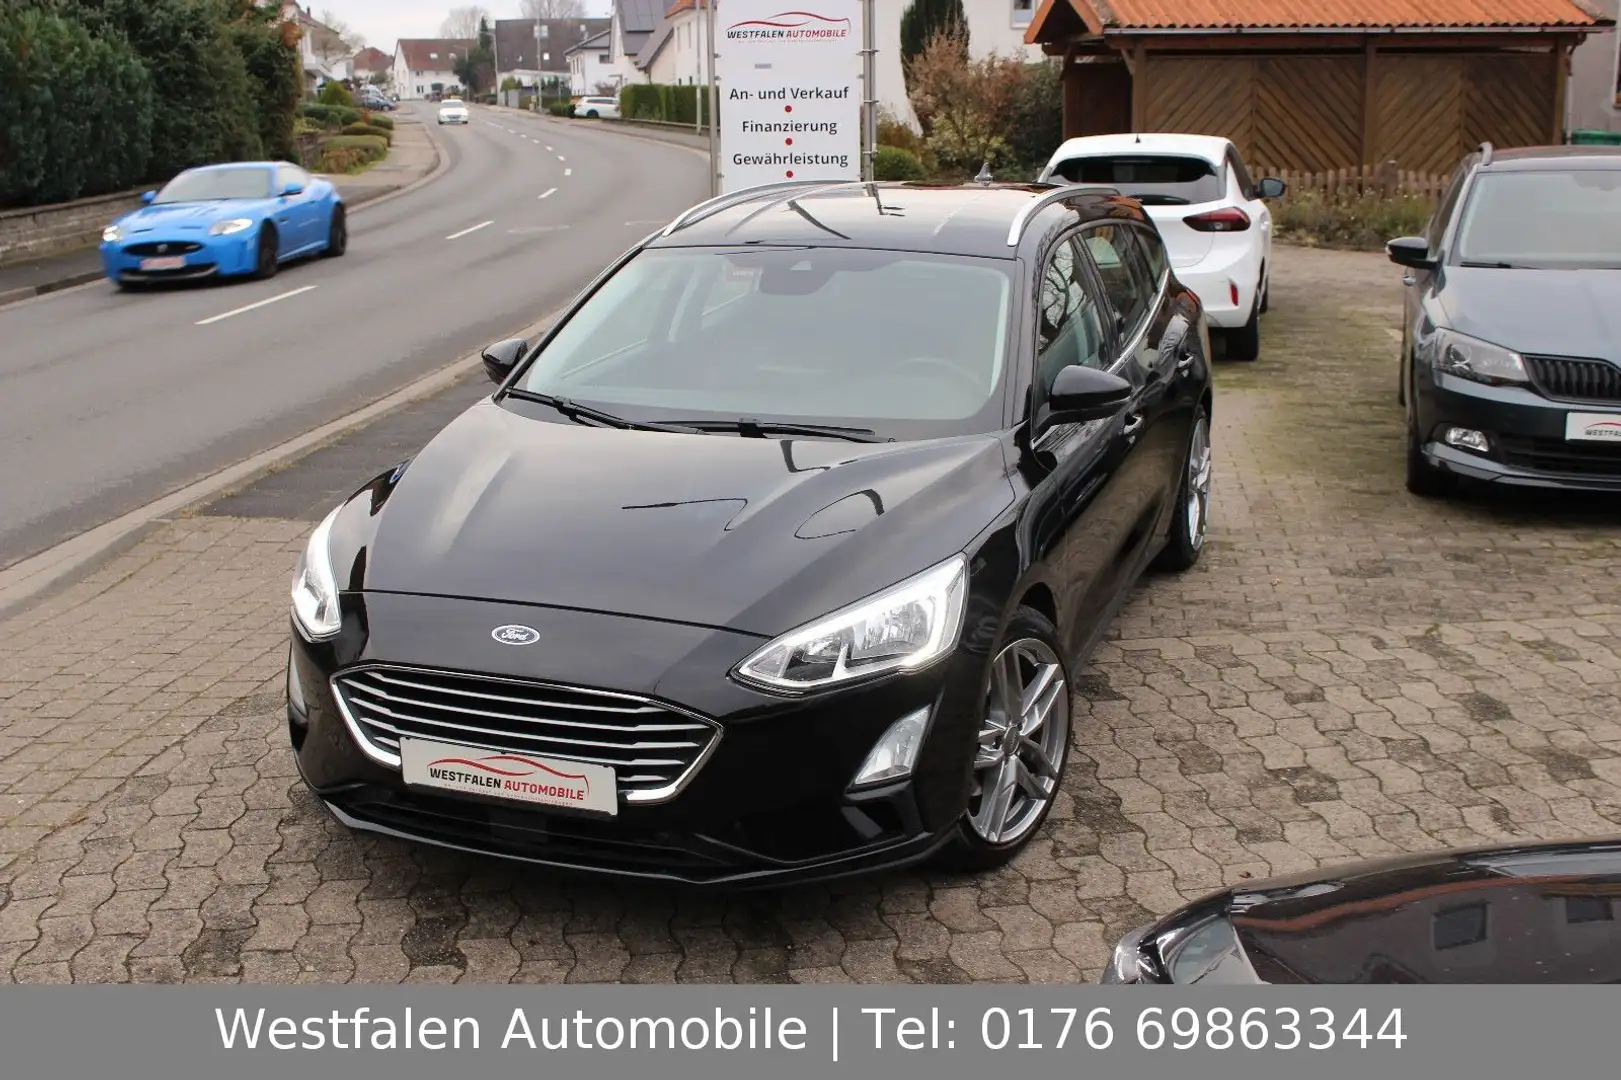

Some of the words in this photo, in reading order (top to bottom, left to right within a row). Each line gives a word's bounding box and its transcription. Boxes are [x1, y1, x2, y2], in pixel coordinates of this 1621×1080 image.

[727, 30, 785, 39] WESTFALEN
[786, 29, 847, 38] AUTOMOBILE
[729, 88, 754, 100] An-
[758, 87, 786, 100] und
[790, 86, 849, 100] Verkauf
[742, 120, 838, 135] Finanzierung
[733, 153, 848, 167] Gewährleistung
[501, 628, 529, 641] Ford
[429, 767, 501, 789] WESTFALEN
[504, 780, 584, 801] AUTOMOBILE
